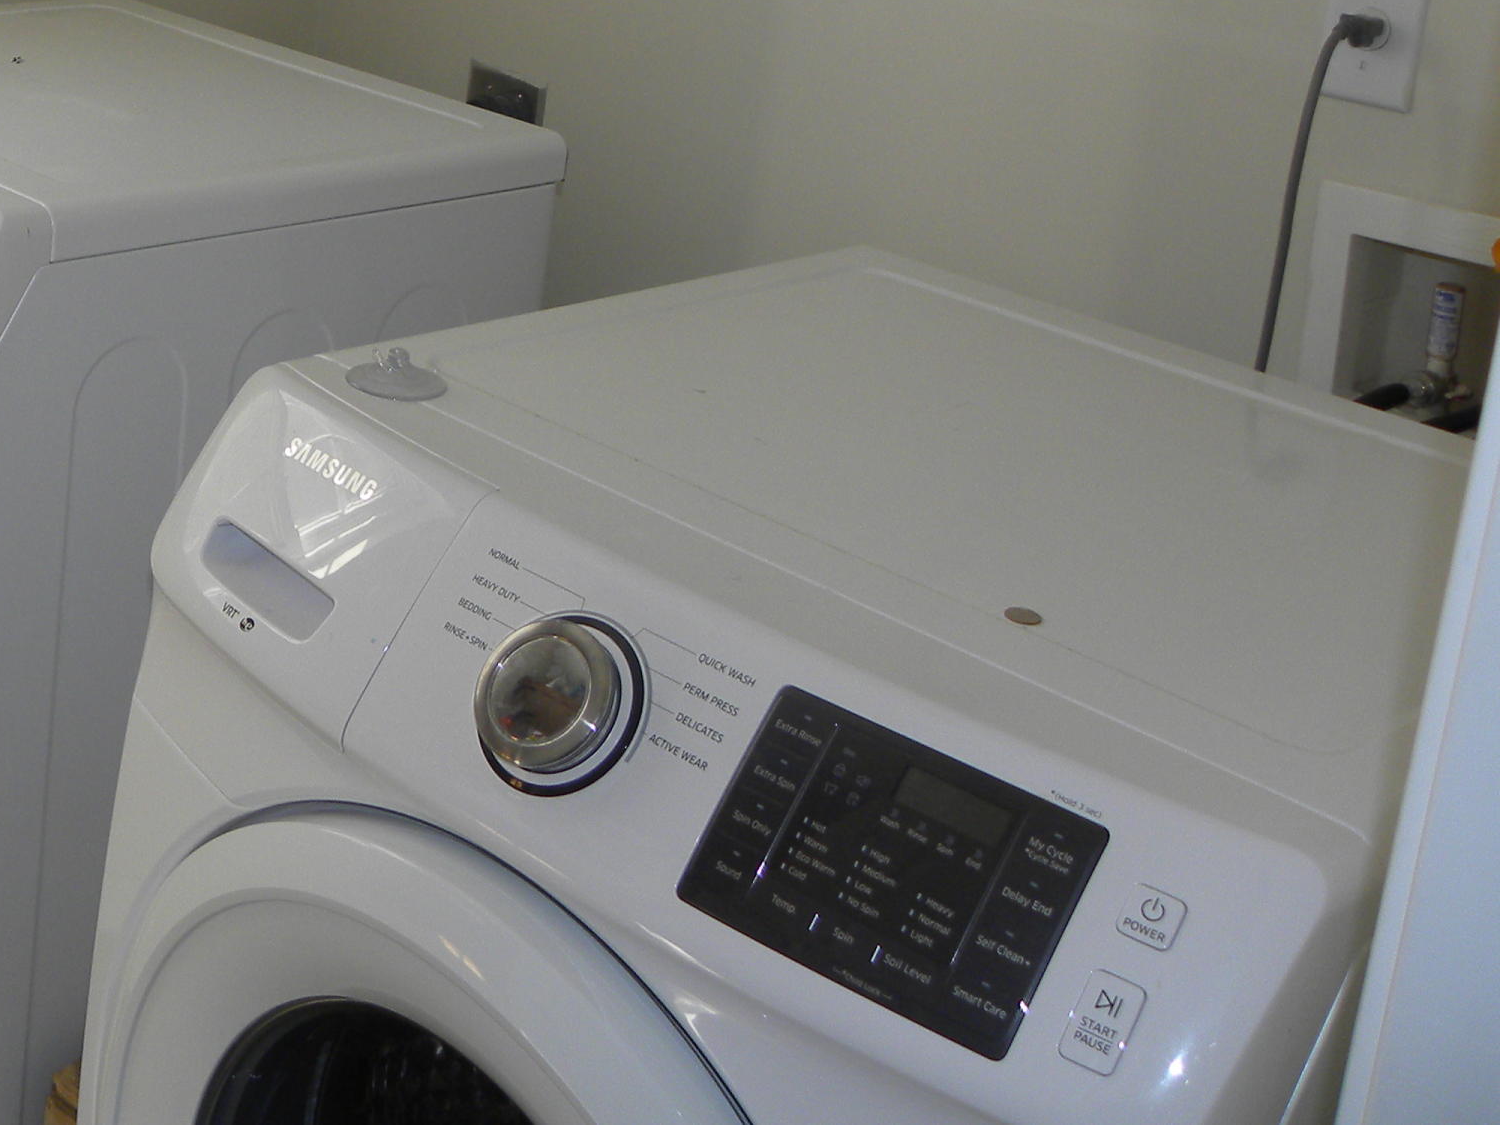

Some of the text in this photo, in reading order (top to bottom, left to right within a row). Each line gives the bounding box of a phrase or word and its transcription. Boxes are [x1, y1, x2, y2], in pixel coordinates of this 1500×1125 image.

[284, 437, 377, 500] SAMSUNG
[488, 548, 520, 570] NORMAL
[472, 574, 521, 603] HEAVY DUTY
[458, 597, 492, 621] BEDDING
[698, 653, 757, 688] QUICK WASH
[682, 682, 740, 717] PERM PRESS
[675, 712, 725, 744] DELICATES
[775, 718, 822, 747] Extra Rinse
[649, 734, 709, 771] ACTIVE WEAR
[753, 765, 796, 792] Extra Spin
[732, 809, 772, 837] Spin Only
[811, 820, 827, 834] Hot
[803, 835, 829, 854] Warm
[1028, 836, 1074, 865] My Cycle
[715, 860, 742, 880] Sound
[788, 866, 807, 881] Cold
[795, 850, 836, 876] Eco Warm
[854, 880, 873, 895] Low
[847, 896, 880, 918] No Spin
[925, 897, 955, 918] Heavy
[1002, 886, 1053, 917] Delay End
[832, 927, 855, 945] Spin
[918, 913, 952, 935] Normal
[1122, 917, 1166, 943] POWER
[910, 929, 933, 948] Light
[975, 934, 997, 951] Self
[883, 953, 932, 985] Soil Level
[952, 985, 1007, 1020] Smart Care
[1080, 1016, 1118, 1040] START
[1073, 1030, 1112, 1056] PAUSE
